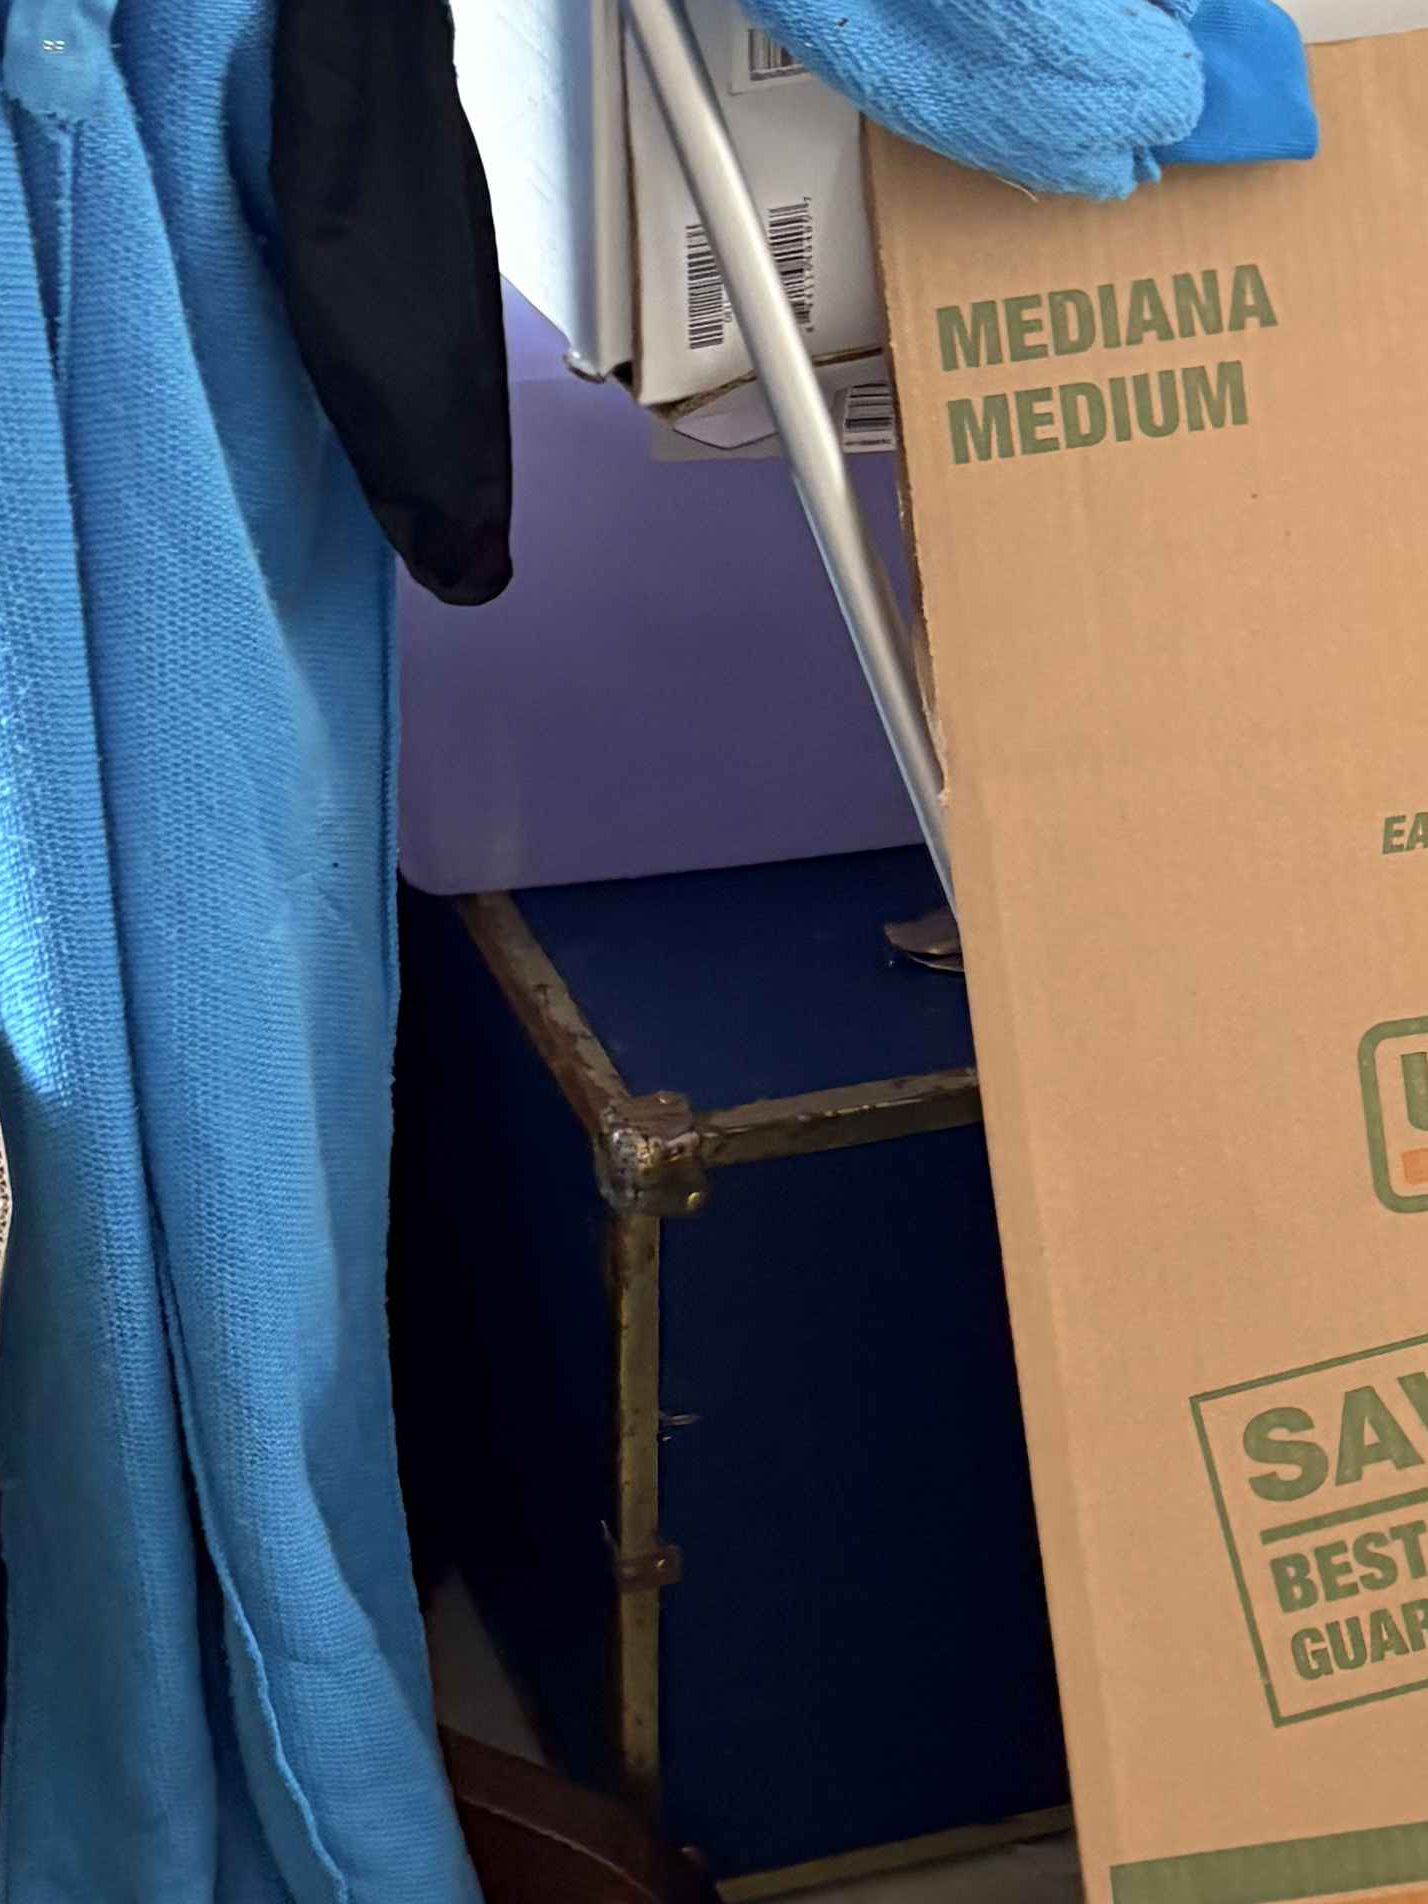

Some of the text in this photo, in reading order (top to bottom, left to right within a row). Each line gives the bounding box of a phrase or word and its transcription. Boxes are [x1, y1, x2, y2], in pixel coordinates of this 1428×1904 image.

[936, 263, 1278, 372] MEDIANA
[946, 360, 1250, 465] MEDIUM
[1269, 1520, 1427, 1614] BEST
